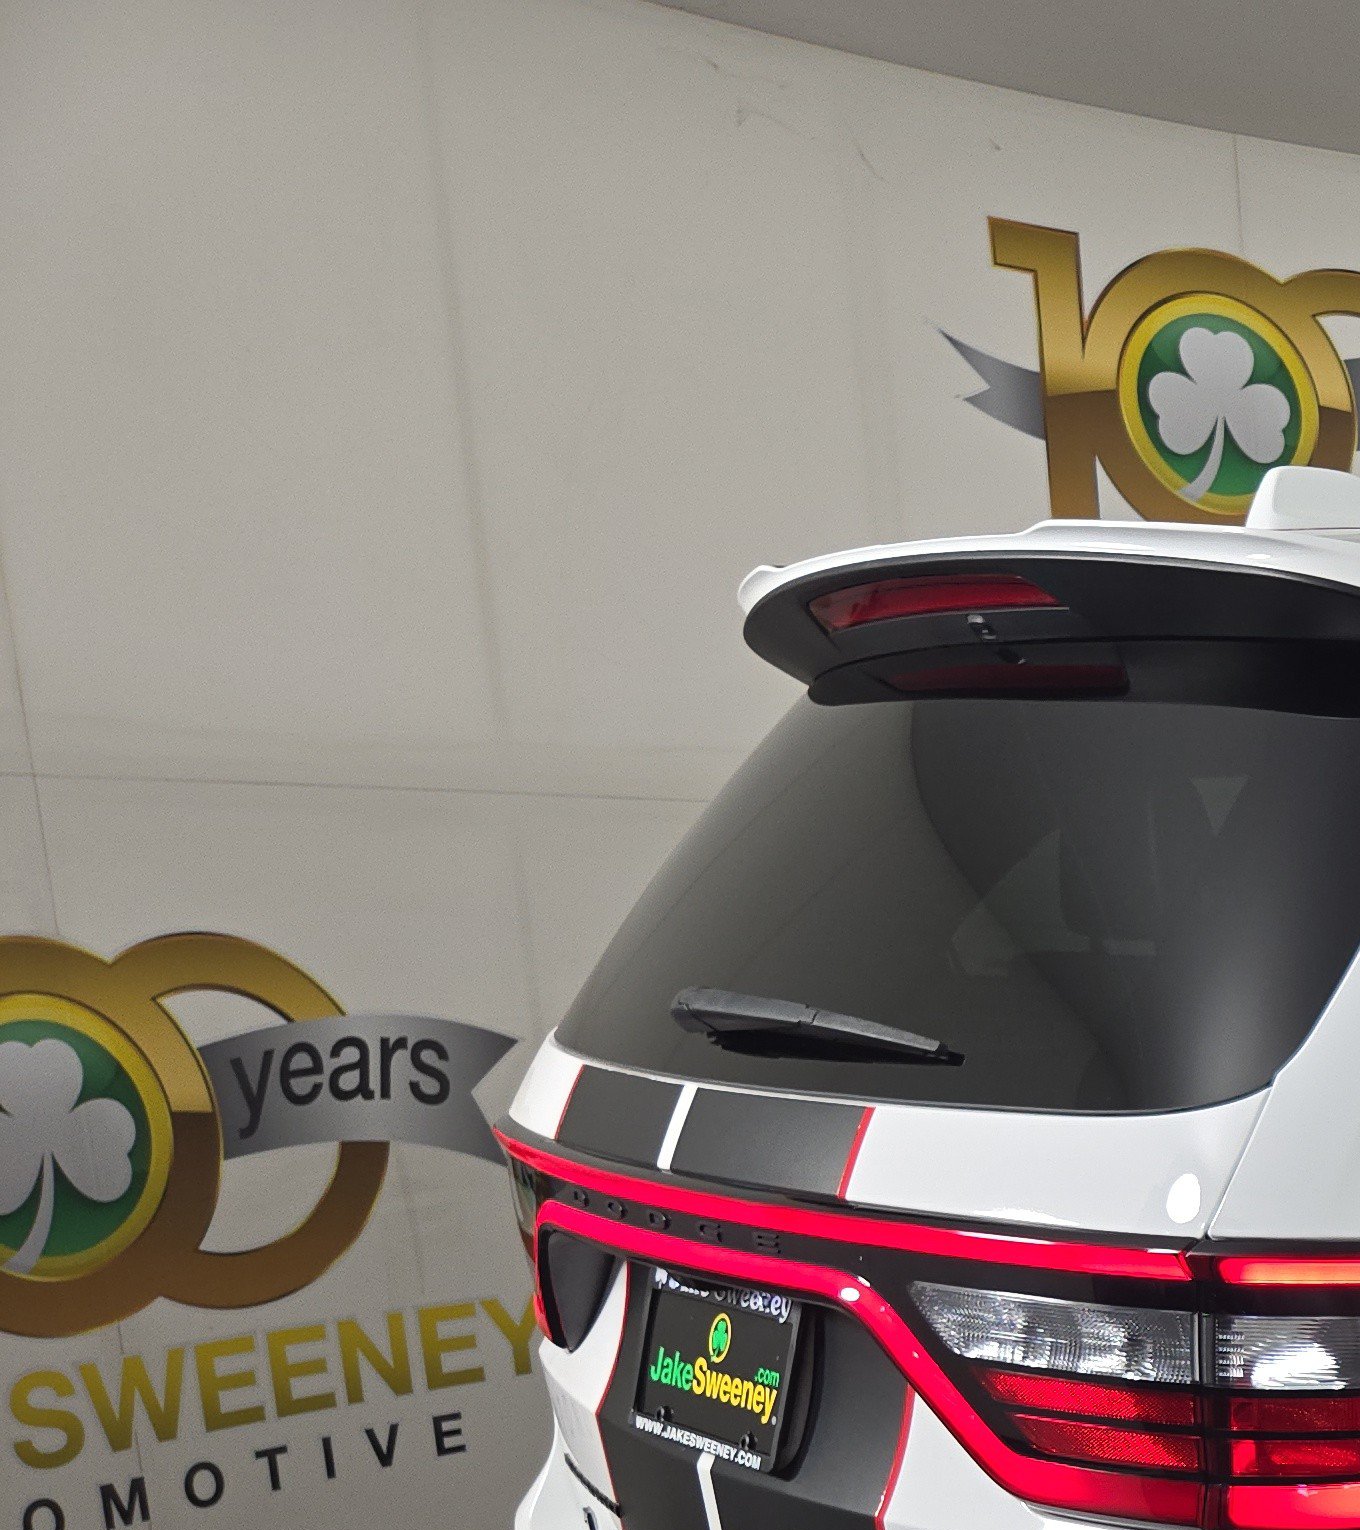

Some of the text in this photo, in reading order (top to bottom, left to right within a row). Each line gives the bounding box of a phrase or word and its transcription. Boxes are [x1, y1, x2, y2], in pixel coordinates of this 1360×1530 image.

[229, 1034, 451, 1140] years
[10, 1297, 538, 1471] SWEENEY
[635, 1415, 762, 1471] WWW.JAKESWEENEY.COM
